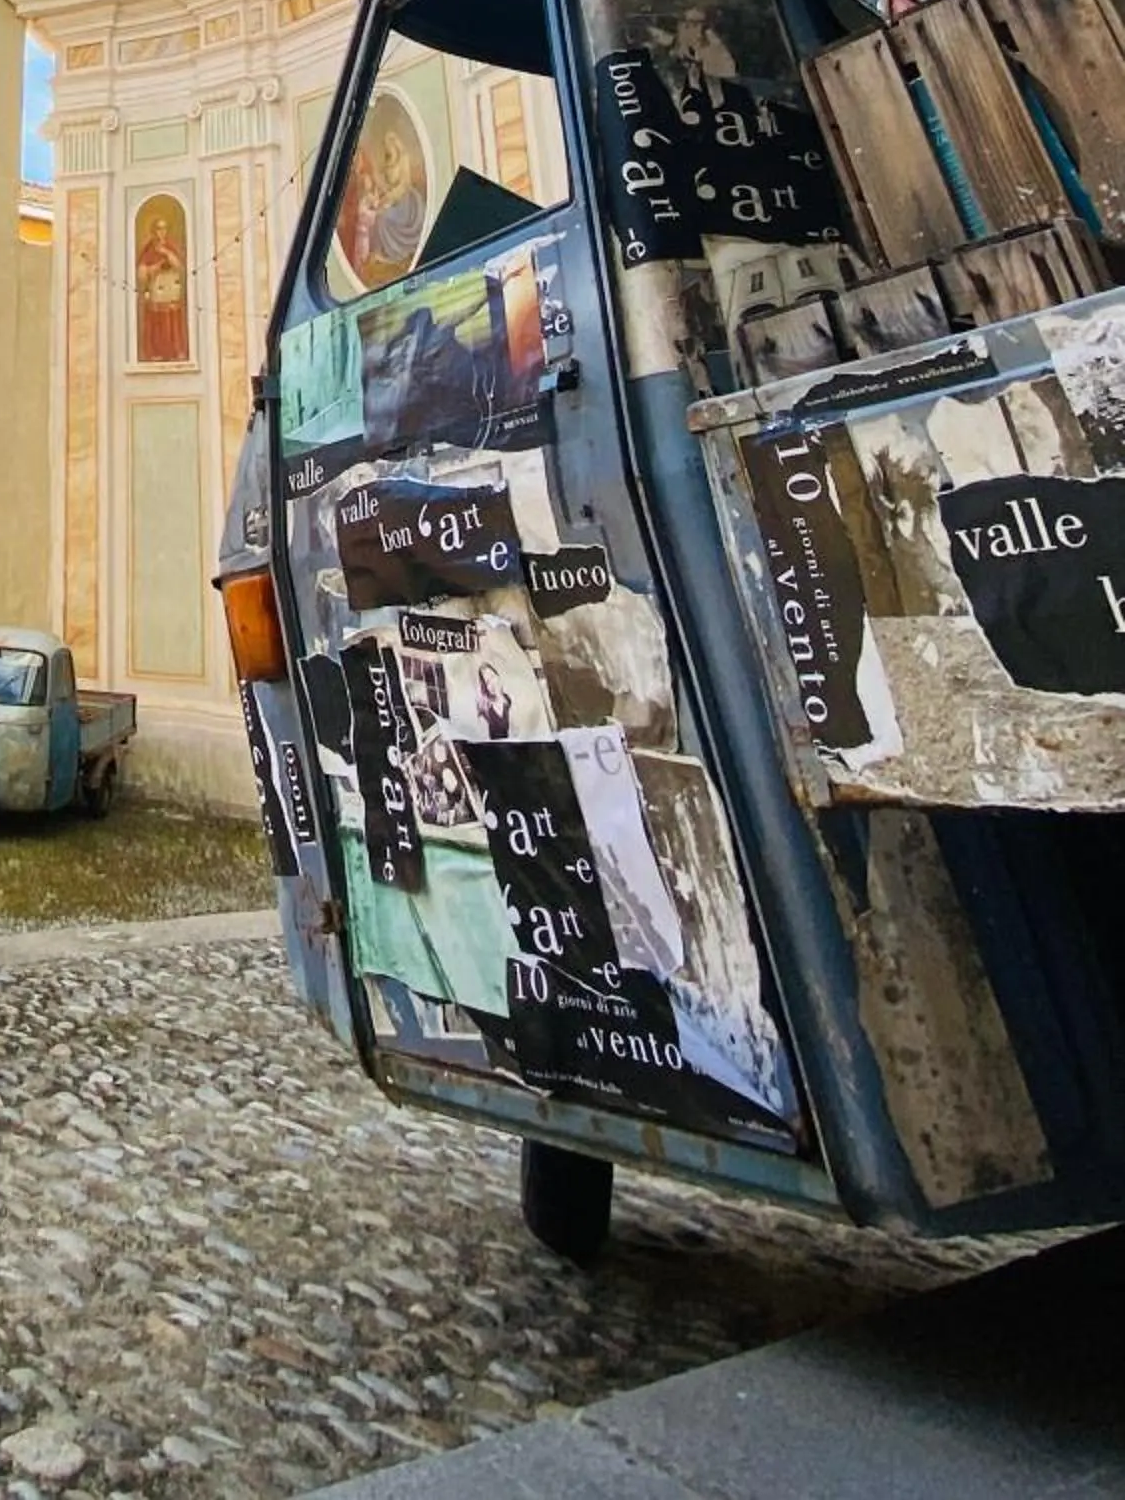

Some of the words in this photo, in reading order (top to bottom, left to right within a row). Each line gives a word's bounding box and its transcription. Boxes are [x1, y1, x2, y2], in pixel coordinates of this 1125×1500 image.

[609, 61, 642, 120] bon
[288, 458, 324, 492] valle
[340, 489, 379, 525] valle
[954, 497, 1087, 560] valle
[378, 523, 412, 553] bon
[792, 516, 823, 579] giorni
[528, 562, 606, 592] fuoco
[815, 588, 830, 609] di
[768, 539, 784, 557] al
[776, 565, 828, 724] vento
[820, 617, 839, 664] arte
[368, 664, 391, 728] bon
[512, 962, 548, 1004] 10
[589, 1027, 683, 1070] vento
